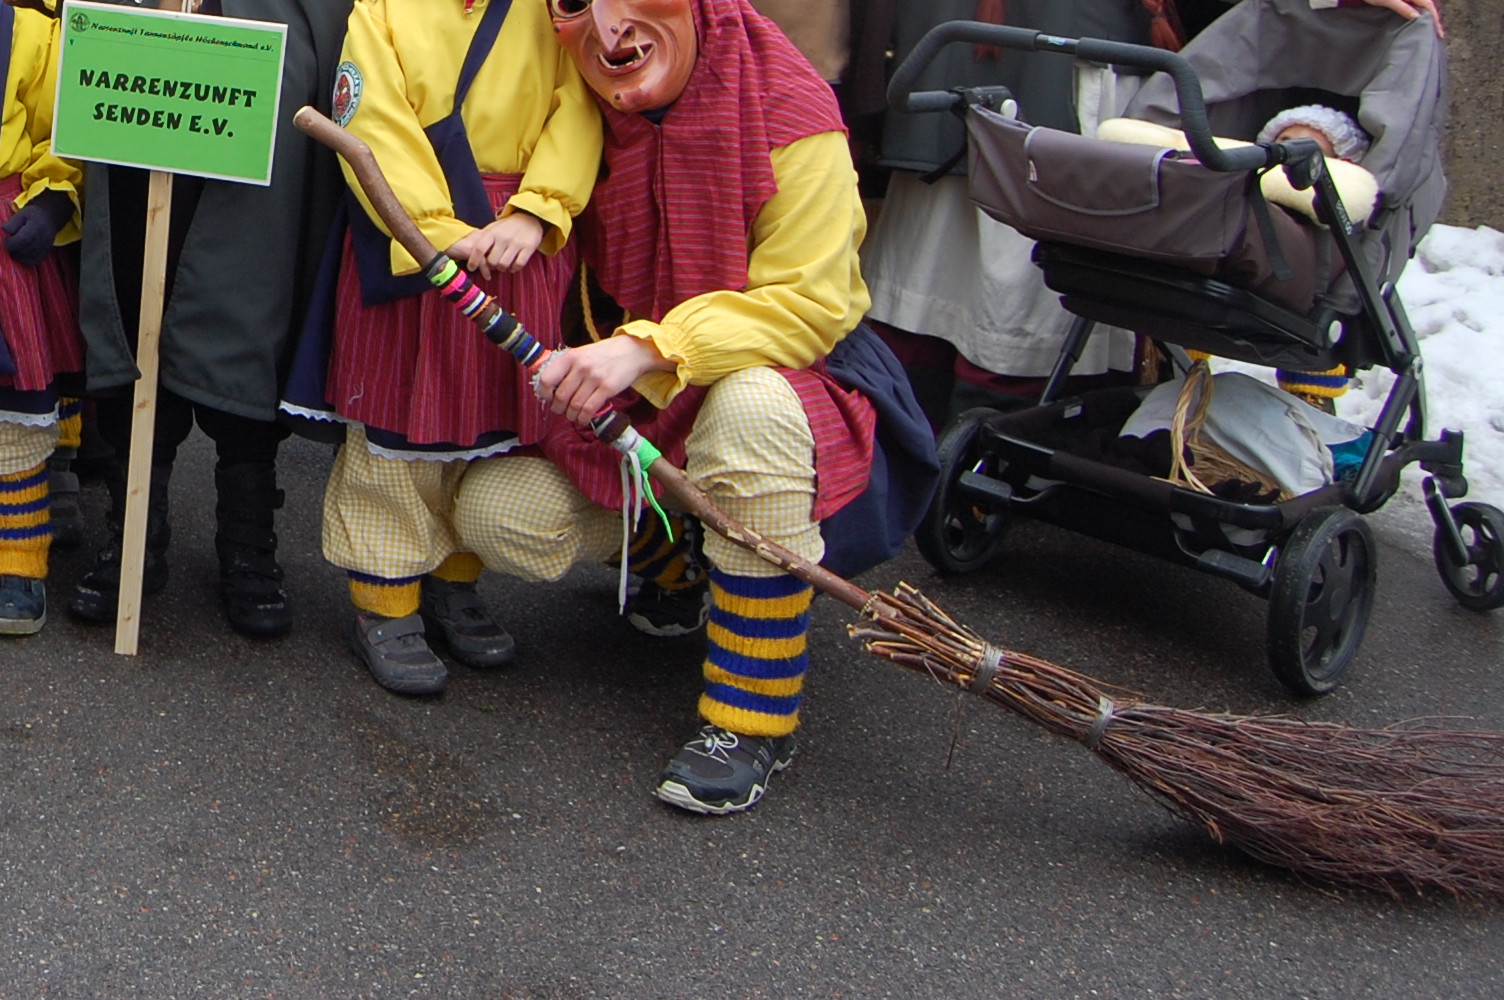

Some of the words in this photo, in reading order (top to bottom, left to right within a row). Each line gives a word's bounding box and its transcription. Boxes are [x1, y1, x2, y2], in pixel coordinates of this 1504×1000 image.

[79, 69, 257, 107] NARRENZUNFT
[93, 102, 182, 130] SENDEN
[188, 114, 234, 138] E.V.
